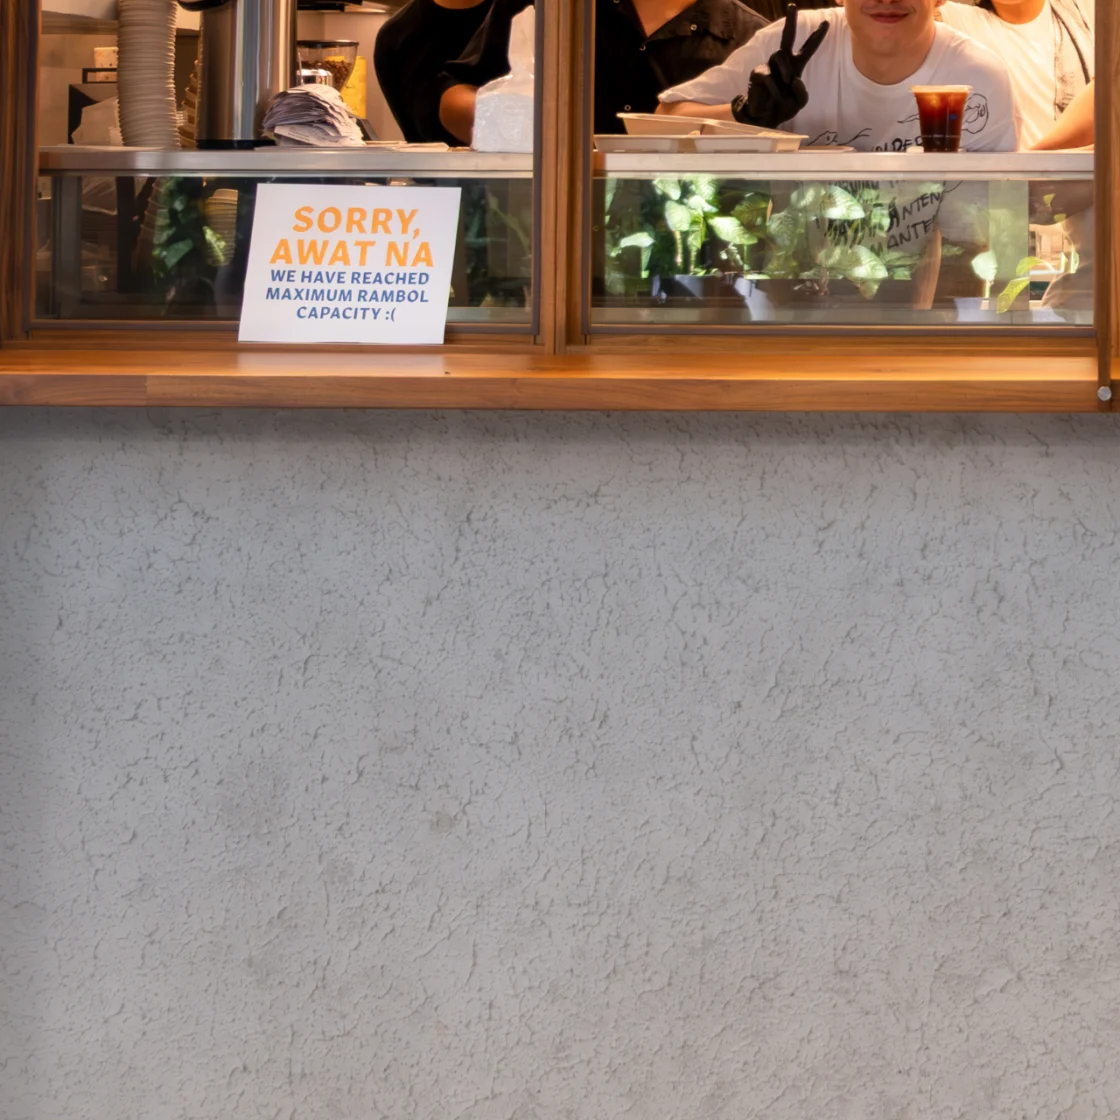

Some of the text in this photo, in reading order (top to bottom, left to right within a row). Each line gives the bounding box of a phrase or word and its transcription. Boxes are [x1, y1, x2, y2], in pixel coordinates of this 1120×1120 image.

[292, 205, 421, 240] SORRY,
[269, 238, 434, 268] AWAT NA
[270, 269, 430, 285] WE HAVE REACHED
[265, 287, 429, 303] MAXIMUM RAMBOL
[296, 306, 382, 320] CAPACITY
